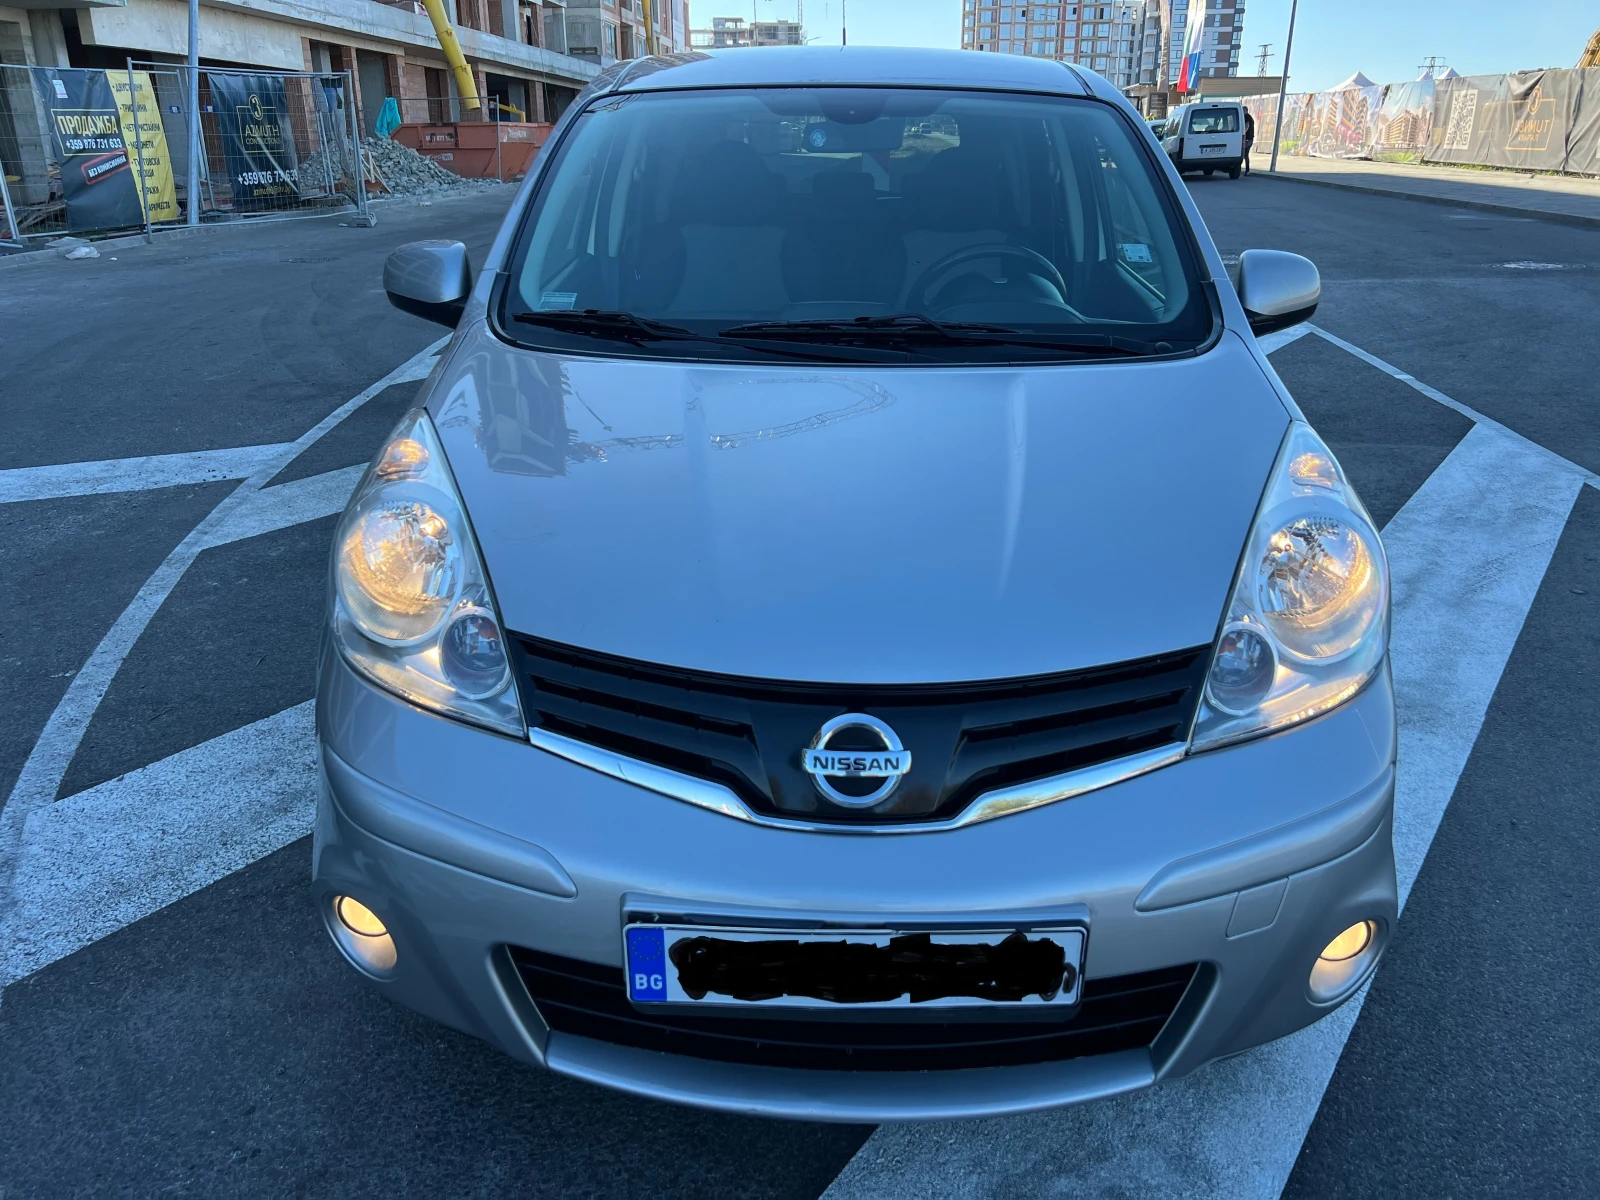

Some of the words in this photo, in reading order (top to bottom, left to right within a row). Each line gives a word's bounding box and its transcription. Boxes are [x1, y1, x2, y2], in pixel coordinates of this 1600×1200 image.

[121, 102, 148, 112] ТРИСЙНИ
[57, 115, 118, 136] ПРОДАЖБА
[124, 121, 161, 132] ЧЕТРИСТАЙНИ
[245, 124, 280, 137] AZIMUTH
[66, 138, 83, 150] +359
[96, 138, 109, 149] 731
[109, 138, 122, 148] 633
[130, 140, 155, 149] МЕОНЕТИ
[238, 172, 258, 185] +359
[812, 755, 900, 772] NISSAN
[635, 973, 663, 990] BG
